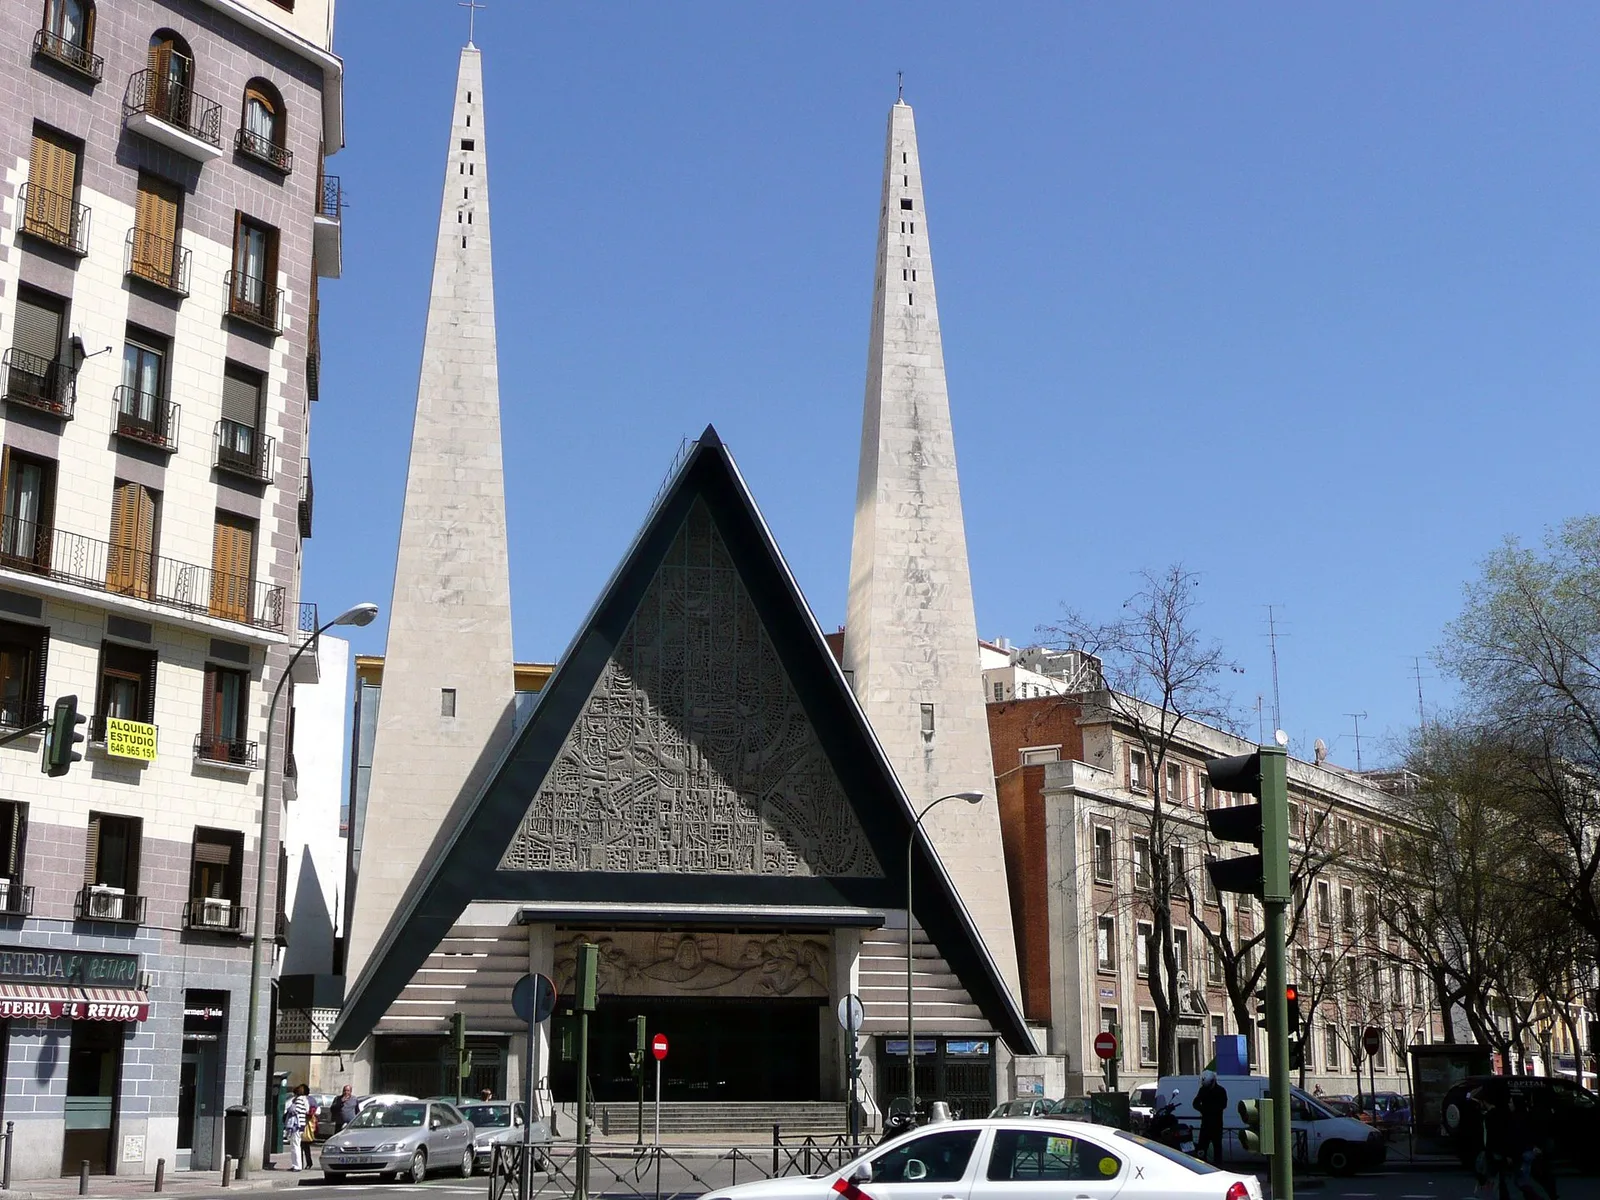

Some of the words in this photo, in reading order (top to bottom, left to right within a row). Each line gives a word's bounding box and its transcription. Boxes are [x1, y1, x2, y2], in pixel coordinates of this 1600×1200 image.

[110, 720, 154, 736] ALQUILO
[110, 731, 154, 747] ESTUDIO
[110, 742, 125, 754] 646
[126, 745, 140, 756] 965
[142, 748, 155, 758] 151
[0, 951, 65, 978] ETERIA
[89, 958, 137, 980] RETIRO
[0, 1001, 52, 1015] TERIA
[61, 1003, 78, 1016] EL
[87, 1003, 139, 1018] RETIRO
[1135, 1166, 1144, 1180] X
